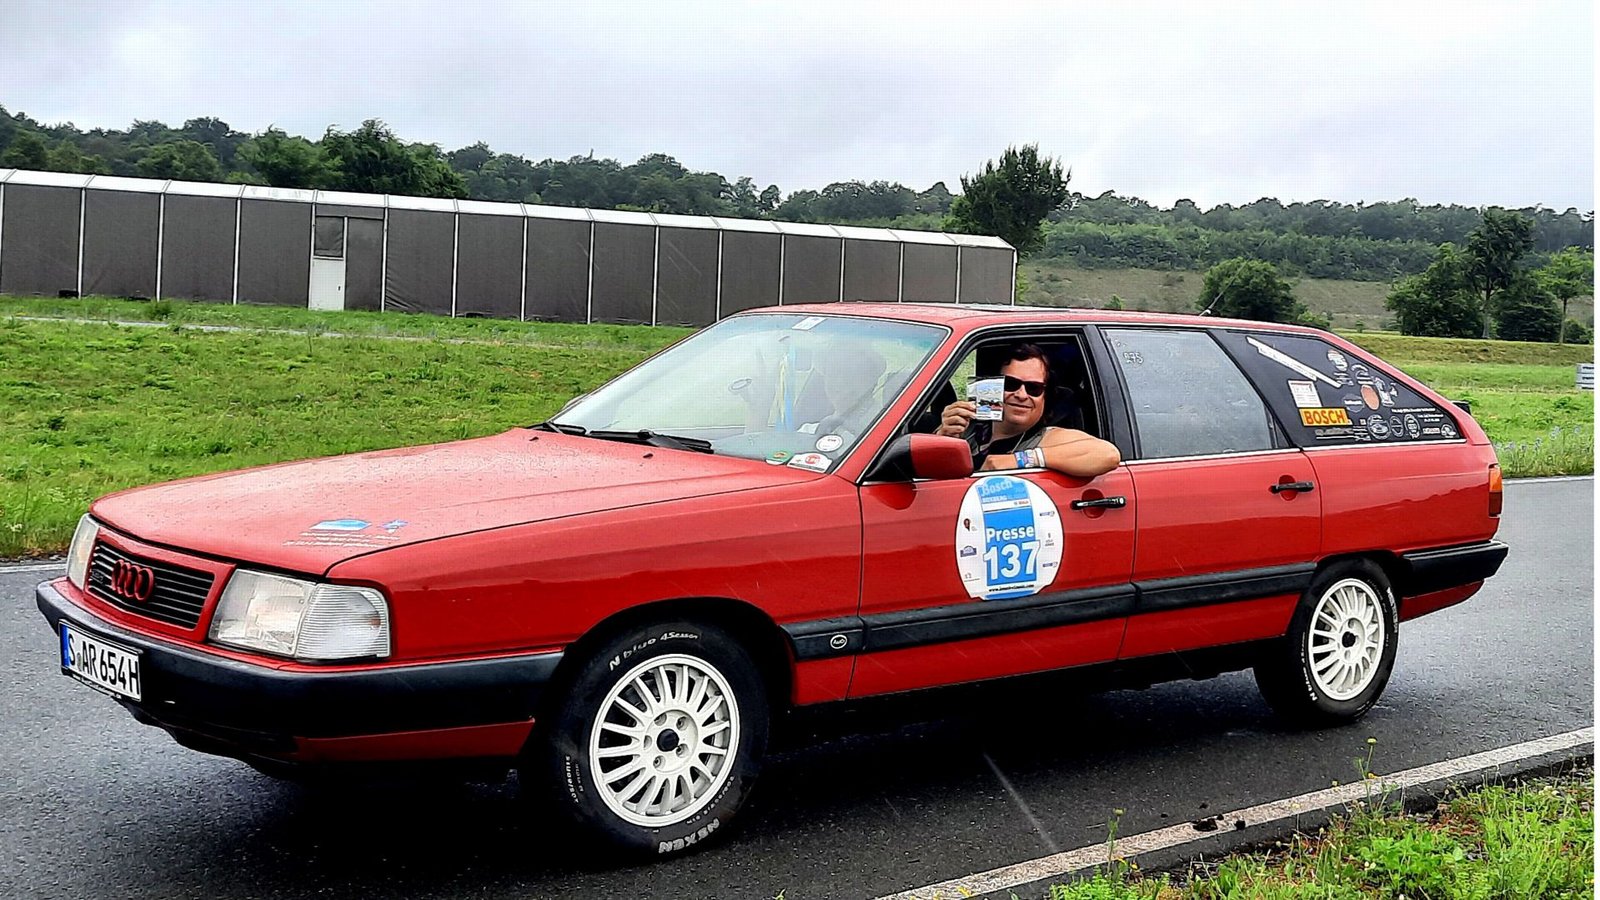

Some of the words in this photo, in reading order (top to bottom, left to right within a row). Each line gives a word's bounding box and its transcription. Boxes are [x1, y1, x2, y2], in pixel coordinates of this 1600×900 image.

[1303, 410, 1345, 424] BOSCH
[980, 479, 1013, 497] Bosch
[986, 526, 1034, 543] Presse
[984, 541, 1040, 579] 137
[68, 634, 75, 665] S
[658, 817, 721, 854] NEXEN
